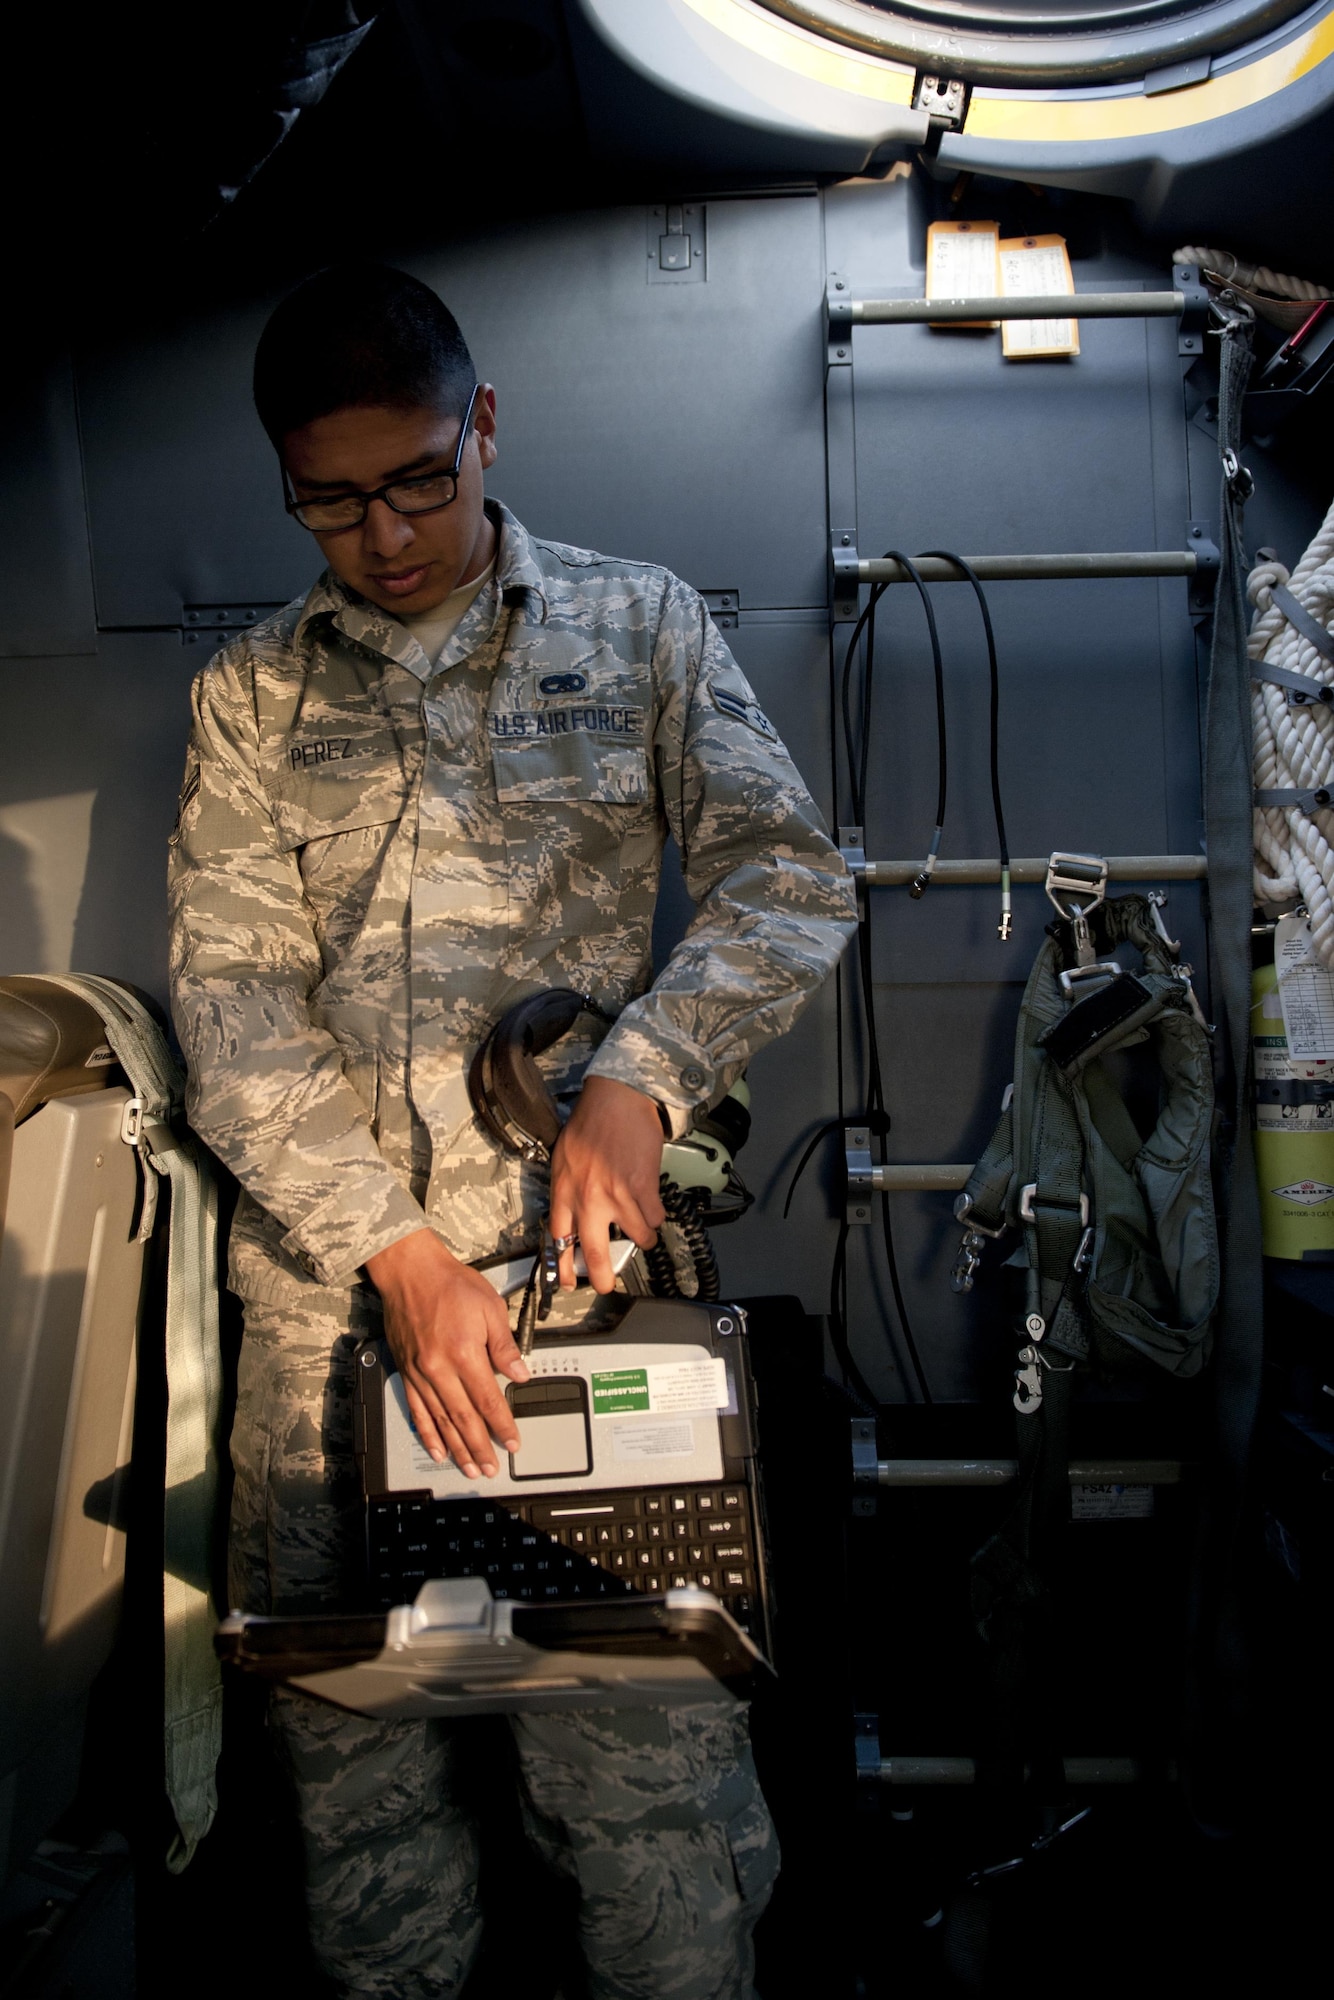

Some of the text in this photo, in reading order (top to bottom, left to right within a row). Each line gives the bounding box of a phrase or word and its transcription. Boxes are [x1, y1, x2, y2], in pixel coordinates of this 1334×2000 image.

[494, 708, 637, 737] U.S. AIR FORCE
[290, 738, 353, 771] PEREZ
[594, 1385, 648, 1397] UNCLASSIFIED
[627, 1529, 633, 1538] C
[652, 1527, 659, 1536] X
[679, 1525, 685, 1534] Z
[577, 1532, 583, 1541] B
[602, 1531, 608, 1539] V
[642, 1553, 649, 1563] D
[668, 1551, 674, 1561] S
[693, 1550, 701, 1559] A
[566, 1560, 572, 1568] H
[591, 1557, 598, 1566] G
[617, 1556, 622, 1565] F
[652, 1579, 657, 1589] E
[676, 1577, 685, 1587] W
[702, 1575, 710, 1585] Q
[600, 1582, 605, 1591] T
[625, 1581, 631, 1590] R
